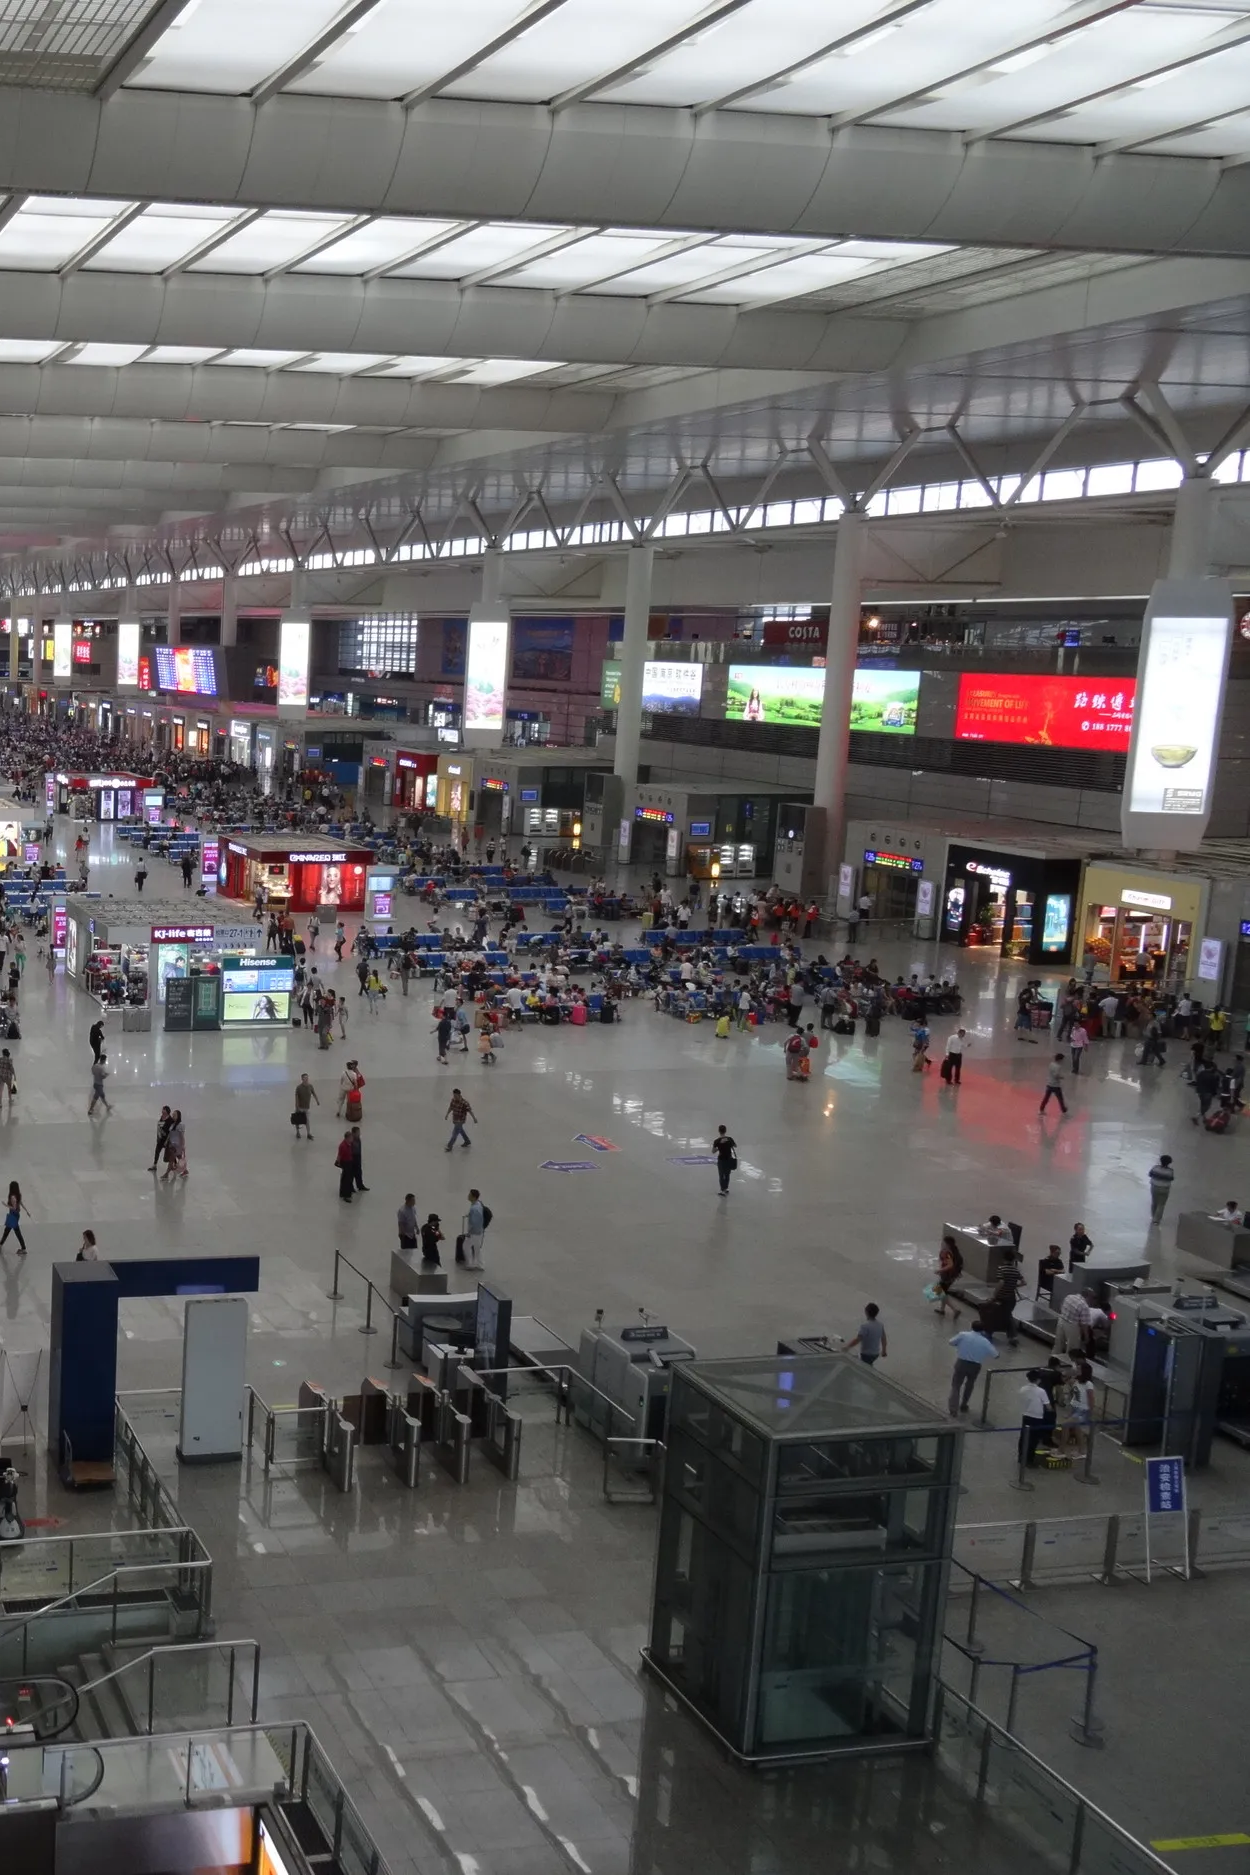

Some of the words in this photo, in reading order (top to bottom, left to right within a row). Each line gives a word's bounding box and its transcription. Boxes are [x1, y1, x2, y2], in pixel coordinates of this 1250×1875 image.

[789, 626, 821, 639] COSTA
[229, 928, 243, 938] 27-1
[239, 957, 277, 967] Hisense
